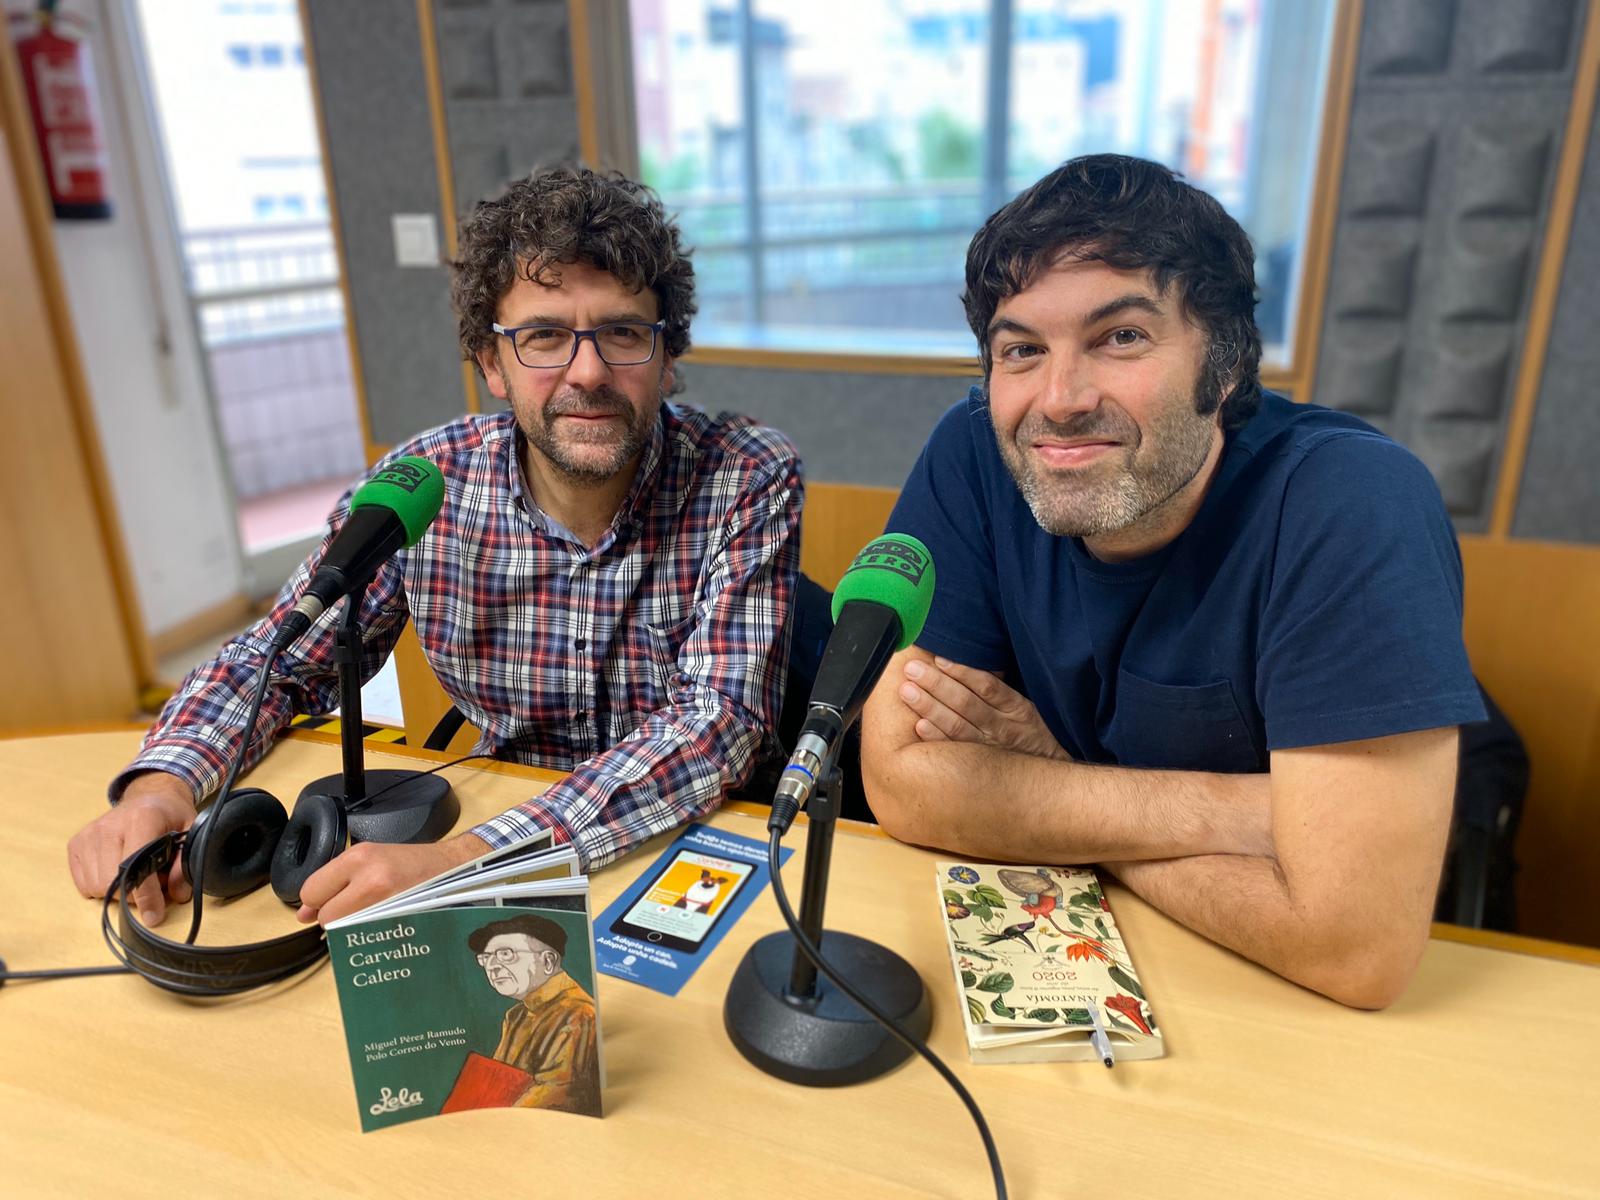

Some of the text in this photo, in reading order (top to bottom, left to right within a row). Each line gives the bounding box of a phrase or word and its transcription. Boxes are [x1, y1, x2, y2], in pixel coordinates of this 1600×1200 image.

[345, 923, 416, 948] Ricardo
[597, 936, 627, 952] Adopta
[612, 935, 643, 950] Adopta
[349, 943, 430, 968] Carvalho
[352, 967, 411, 987] Calero
[1032, 971, 1078, 981] 2020
[364, 1026, 466, 1053] Miguel Pérez Ramudo
[366, 1037, 466, 1062] Polo Correo do Vento
[369, 1086, 424, 1115] Lela
